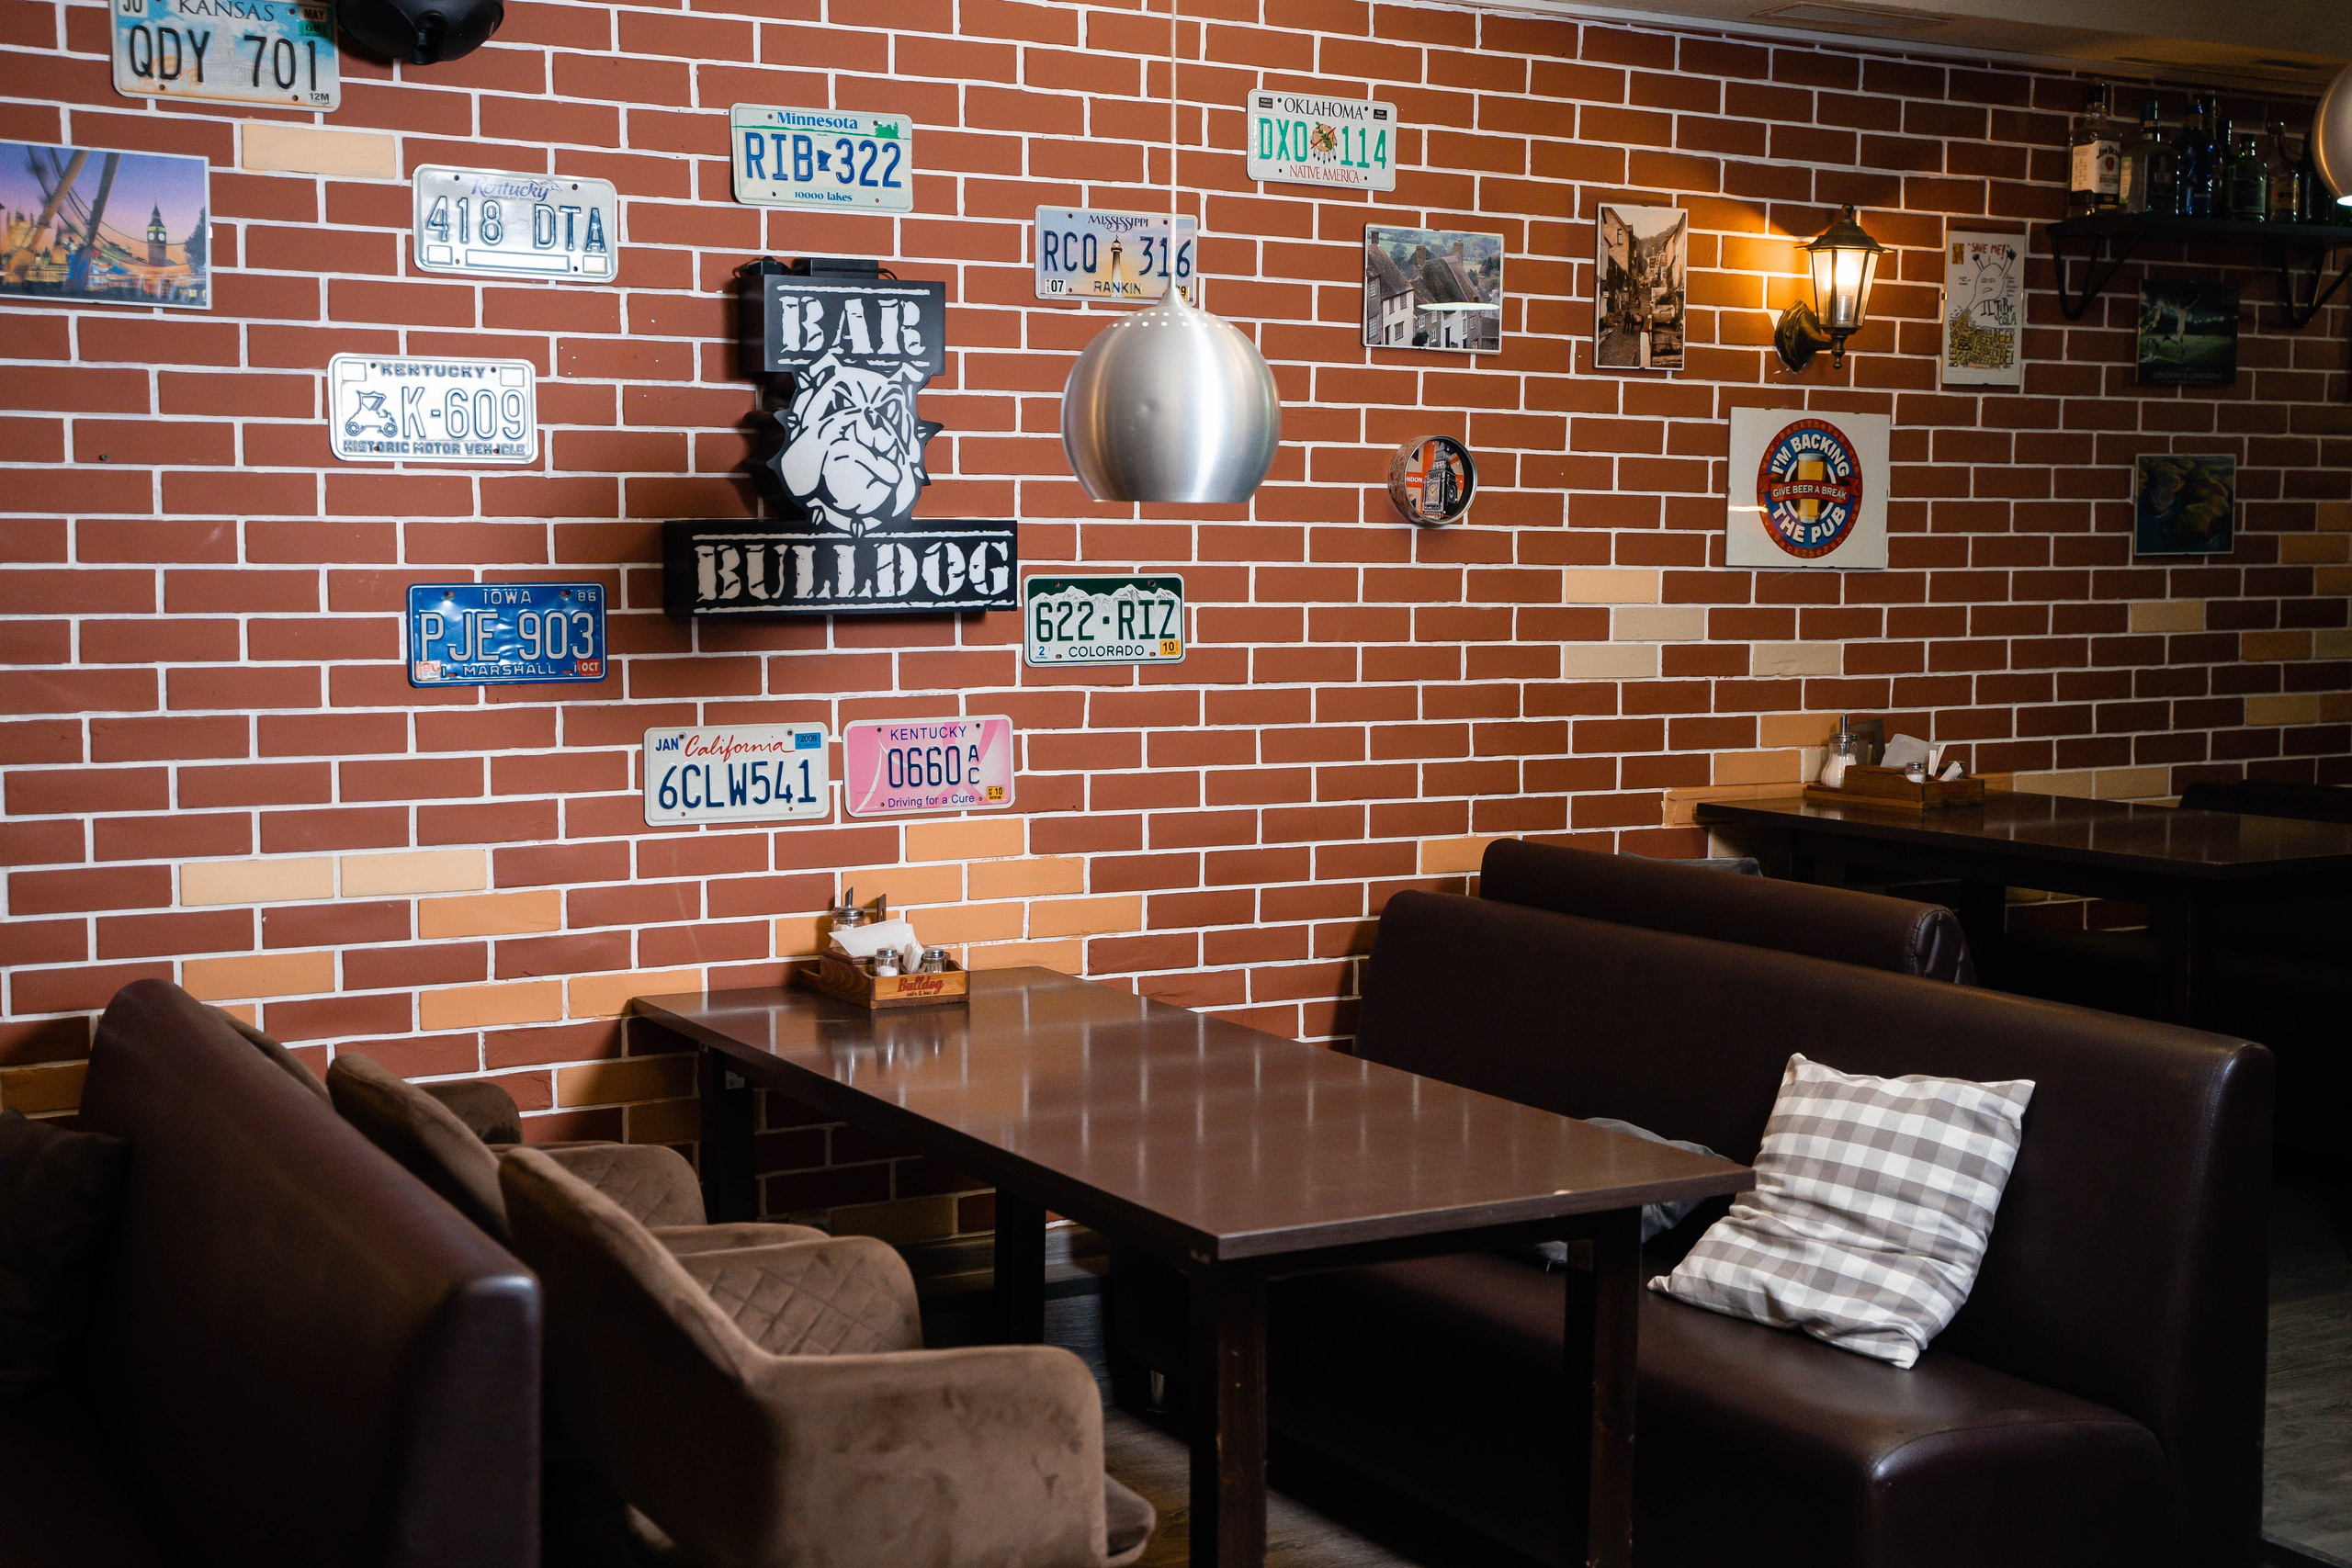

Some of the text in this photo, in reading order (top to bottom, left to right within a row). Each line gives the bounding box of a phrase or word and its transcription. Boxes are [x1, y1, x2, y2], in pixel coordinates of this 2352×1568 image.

[178, 0, 275, 21] KANSAS
[304, 8, 324, 20] MAY
[130, 26, 317, 91] QDY 701
[309, 93, 329, 101] 12M
[1284, 97, 1363, 120] OKLAHOMA
[777, 111, 858, 130] Minnesota
[1340, 126, 1386, 169] 114
[745, 131, 902, 187] RIB 322
[1290, 164, 1320, 180] NATIVE
[471, 179, 549, 202] Kentucky
[795, 191, 853, 202] 10000 lakes
[427, 196, 607, 253] 418 DTA
[1088, 214, 1148, 233] MISSISSIPPI
[1138, 236, 1192, 277] 316
[1051, 280, 1064, 293] 07
[1093, 281, 1142, 294] RANKIN
[778, 295, 926, 356] BAR
[380, 363, 486, 378] KENTUCKY
[401, 386, 526, 440] K-609
[343, 440, 526, 456] HISTORIC MOTOR VEHICLE
[1771, 434, 1850, 478] I'M BACKING
[1773, 484, 1847, 501] GIVE BEER A BREAK
[1772, 502, 1847, 544] THE PUB
[694, 540, 1009, 603] BULLDOG
[483, 590, 597, 604] IOWA 86
[420, 612, 594, 661] PJE 903
[1039, 646, 1046, 656] 2
[1069, 645, 1145, 658] COLORADO
[1163, 641, 1175, 651] 10
[463, 663, 556, 676] MARSHALL
[582, 661, 599, 671] OCT
[800, 735, 817, 743] 2009
[890, 726, 967, 740] KENTUCKY
[655, 738, 679, 751] JAN
[684, 735, 796, 762] California
[888, 746, 961, 788] 0660
[659, 759, 817, 809] 6CLW541
[994, 786, 1003, 795] 10
[888, 797, 922, 808] Driving
[926, 795, 939, 806] for
[951, 794, 975, 804] Cure
[898, 976, 944, 994] Bulldog
